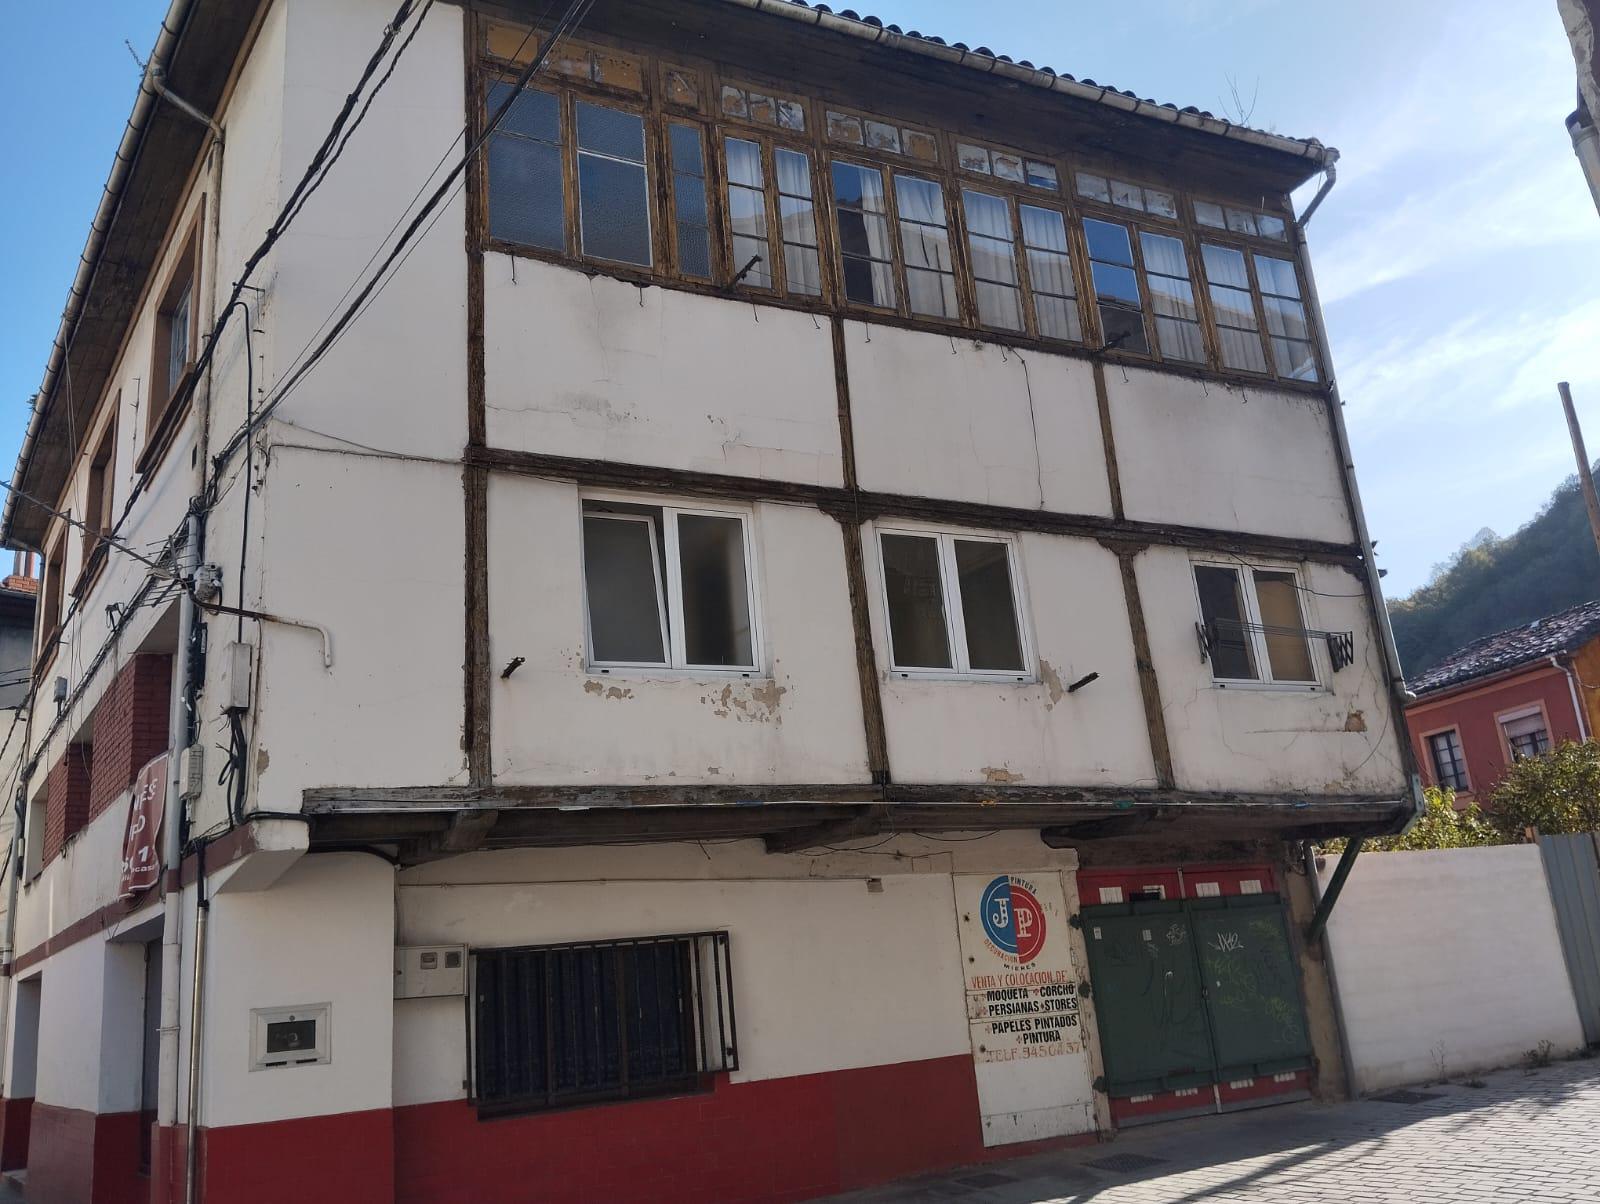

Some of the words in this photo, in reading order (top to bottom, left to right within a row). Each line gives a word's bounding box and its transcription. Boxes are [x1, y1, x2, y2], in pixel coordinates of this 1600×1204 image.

[1010, 876, 1038, 895] PINTURA
[1003, 962, 1036, 972] MIERES
[971, 975, 995, 989] VENTA
[996, 974, 1003, 986] Y
[1056, 969, 1066, 983] DE
[986, 988, 1029, 1002] MOQUETA
[1039, 983, 1075, 997] CORCHO
[988, 1001, 1040, 1016] PERSIANAS
[1044, 997, 1077, 1011] STORES
[992, 1019, 1032, 1034] PAPELES
[1034, 1015, 1077, 1030] PINTADOS
[1023, 1030, 1062, 1045] PINTURA
